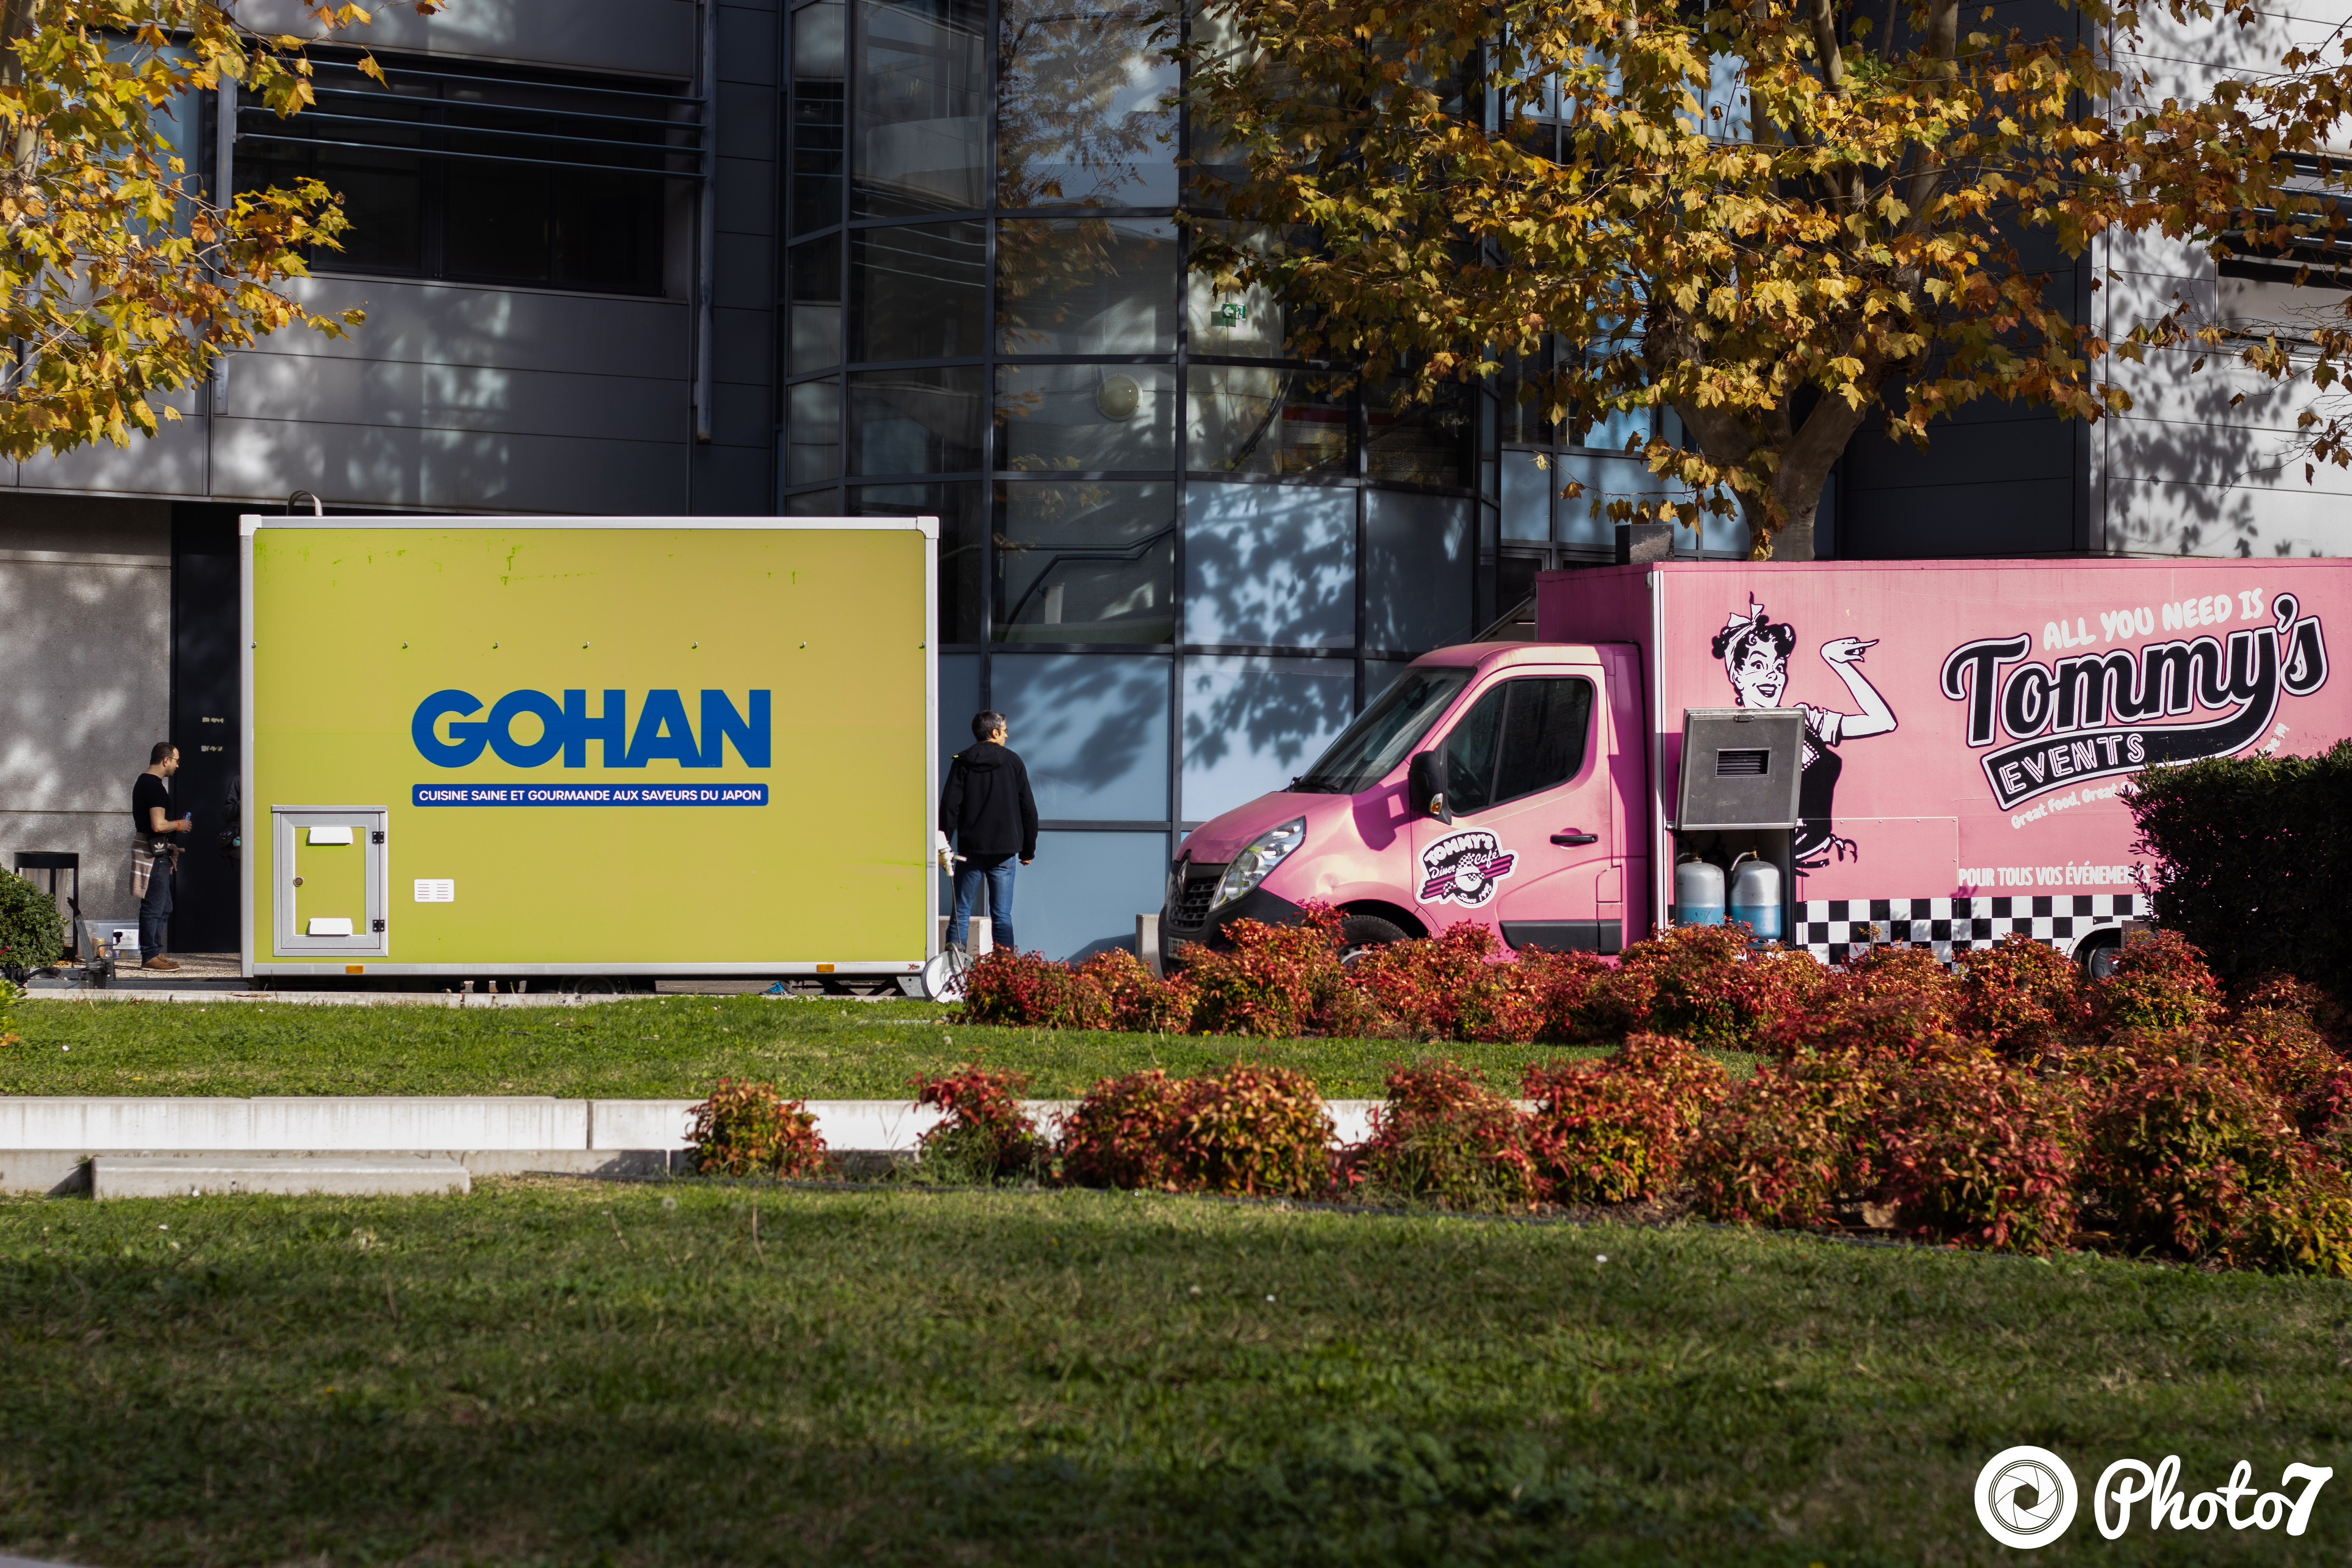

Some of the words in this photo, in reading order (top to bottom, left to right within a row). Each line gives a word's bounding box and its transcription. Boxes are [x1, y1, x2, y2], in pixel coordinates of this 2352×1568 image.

[2043, 619, 2096, 651] ALL
[2100, 607, 2154, 643] YOU
[2161, 594, 2233, 632] NEED
[2238, 587, 2264, 620] IS
[1940, 592, 2329, 760] Tommy's
[411, 689, 771, 768] GOHAN
[1998, 733, 2145, 795] EVENTS
[419, 790, 468, 801] CUISINE
[471, 790, 507, 800] SAINE
[511, 790, 525, 800] ET
[528, 790, 610, 800] GOURMANDE
[613, 790, 639, 800] AUX
[642, 790, 698, 800] SAVEURS
[701, 790, 718, 800] DU
[721, 790, 761, 800] JAPON
[2011, 803, 2048, 829] Great
[2047, 791, 2081, 813] Food,
[2082, 783, 2118, 803] Great
[1428, 864, 1456, 879] Diner
[1474, 848, 1500, 869] Café
[1958, 867, 1994, 887] POUR
[1997, 867, 2034, 886] TOUS
[2035, 866, 2063, 886] VOS
[2065, 860, 2151, 885] ÉVÉNEMENS
[1457, 893, 1477, 904] Since
